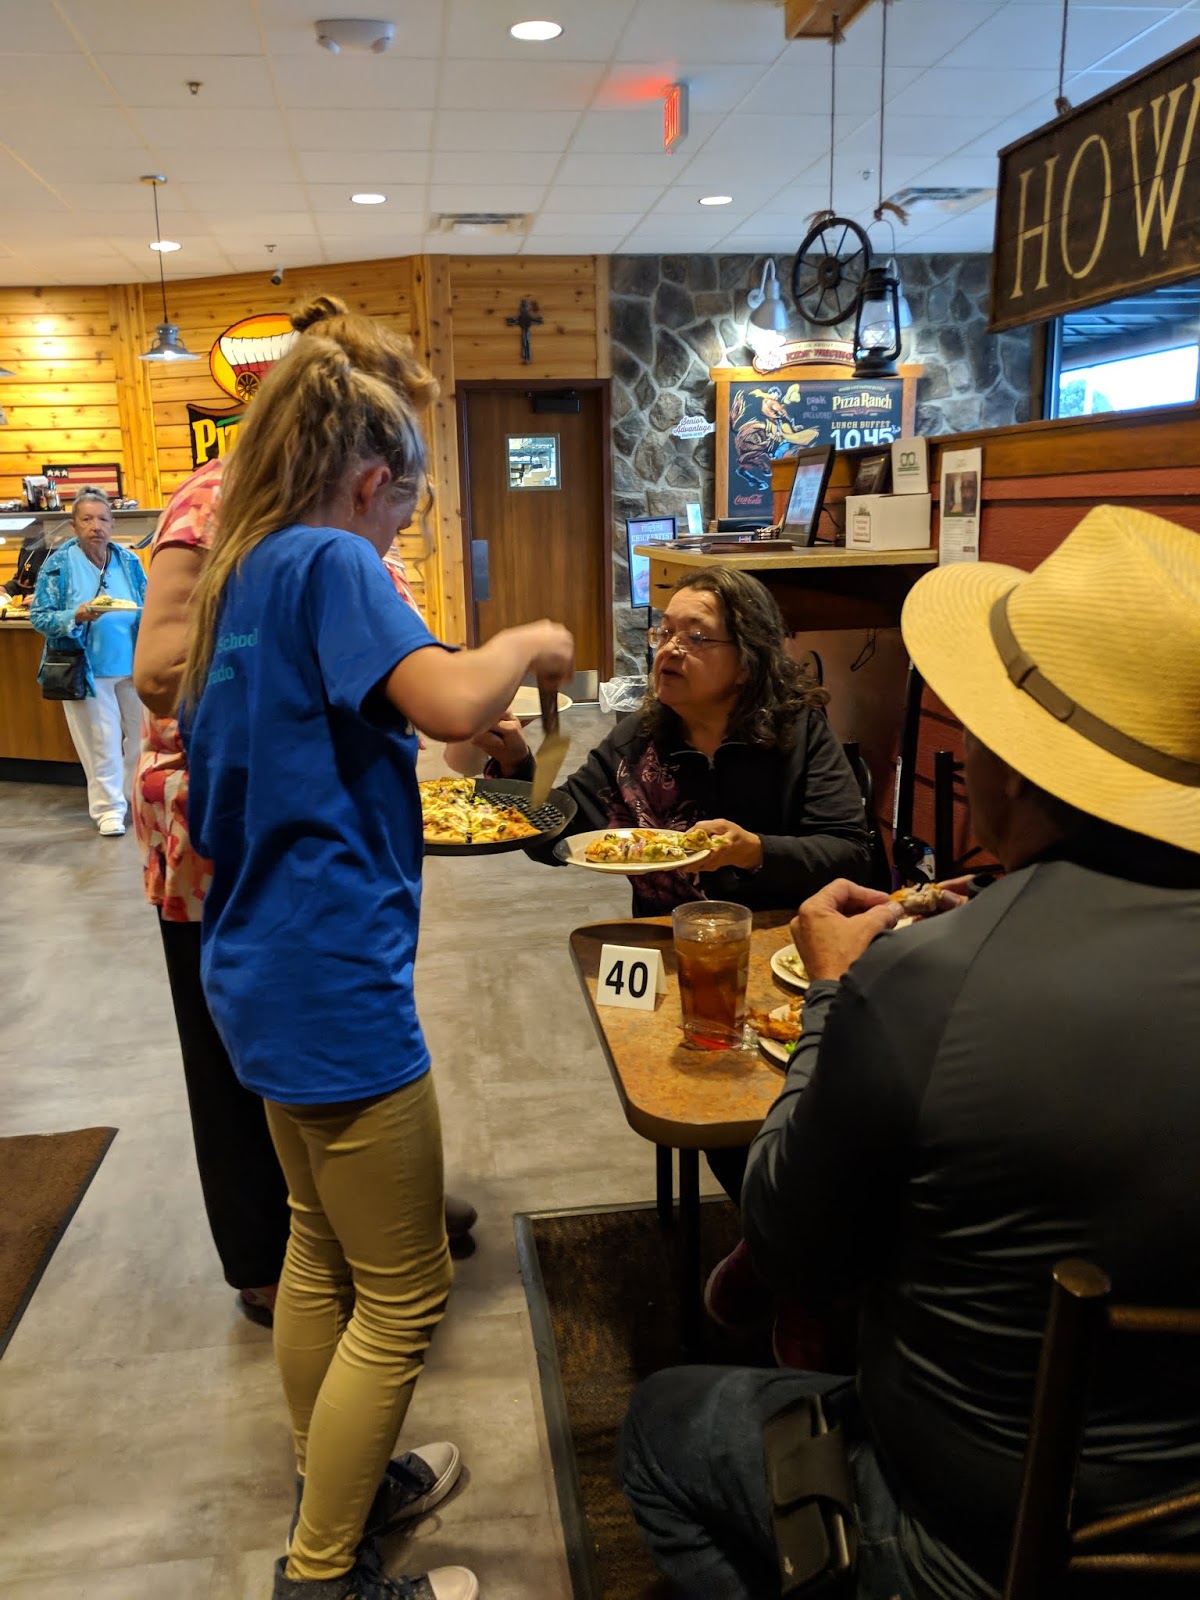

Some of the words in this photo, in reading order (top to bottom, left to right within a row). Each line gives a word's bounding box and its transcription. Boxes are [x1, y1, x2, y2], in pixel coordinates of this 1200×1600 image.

[832, 395, 860, 411] Pizza
[861, 392, 892, 410] Ranch
[681, 416, 704, 426] Senior
[831, 421, 858, 430] LUNCH
[859, 420, 891, 429] BUFFET
[673, 424, 712, 434] Advantage
[605, 960, 648, 998] 40
